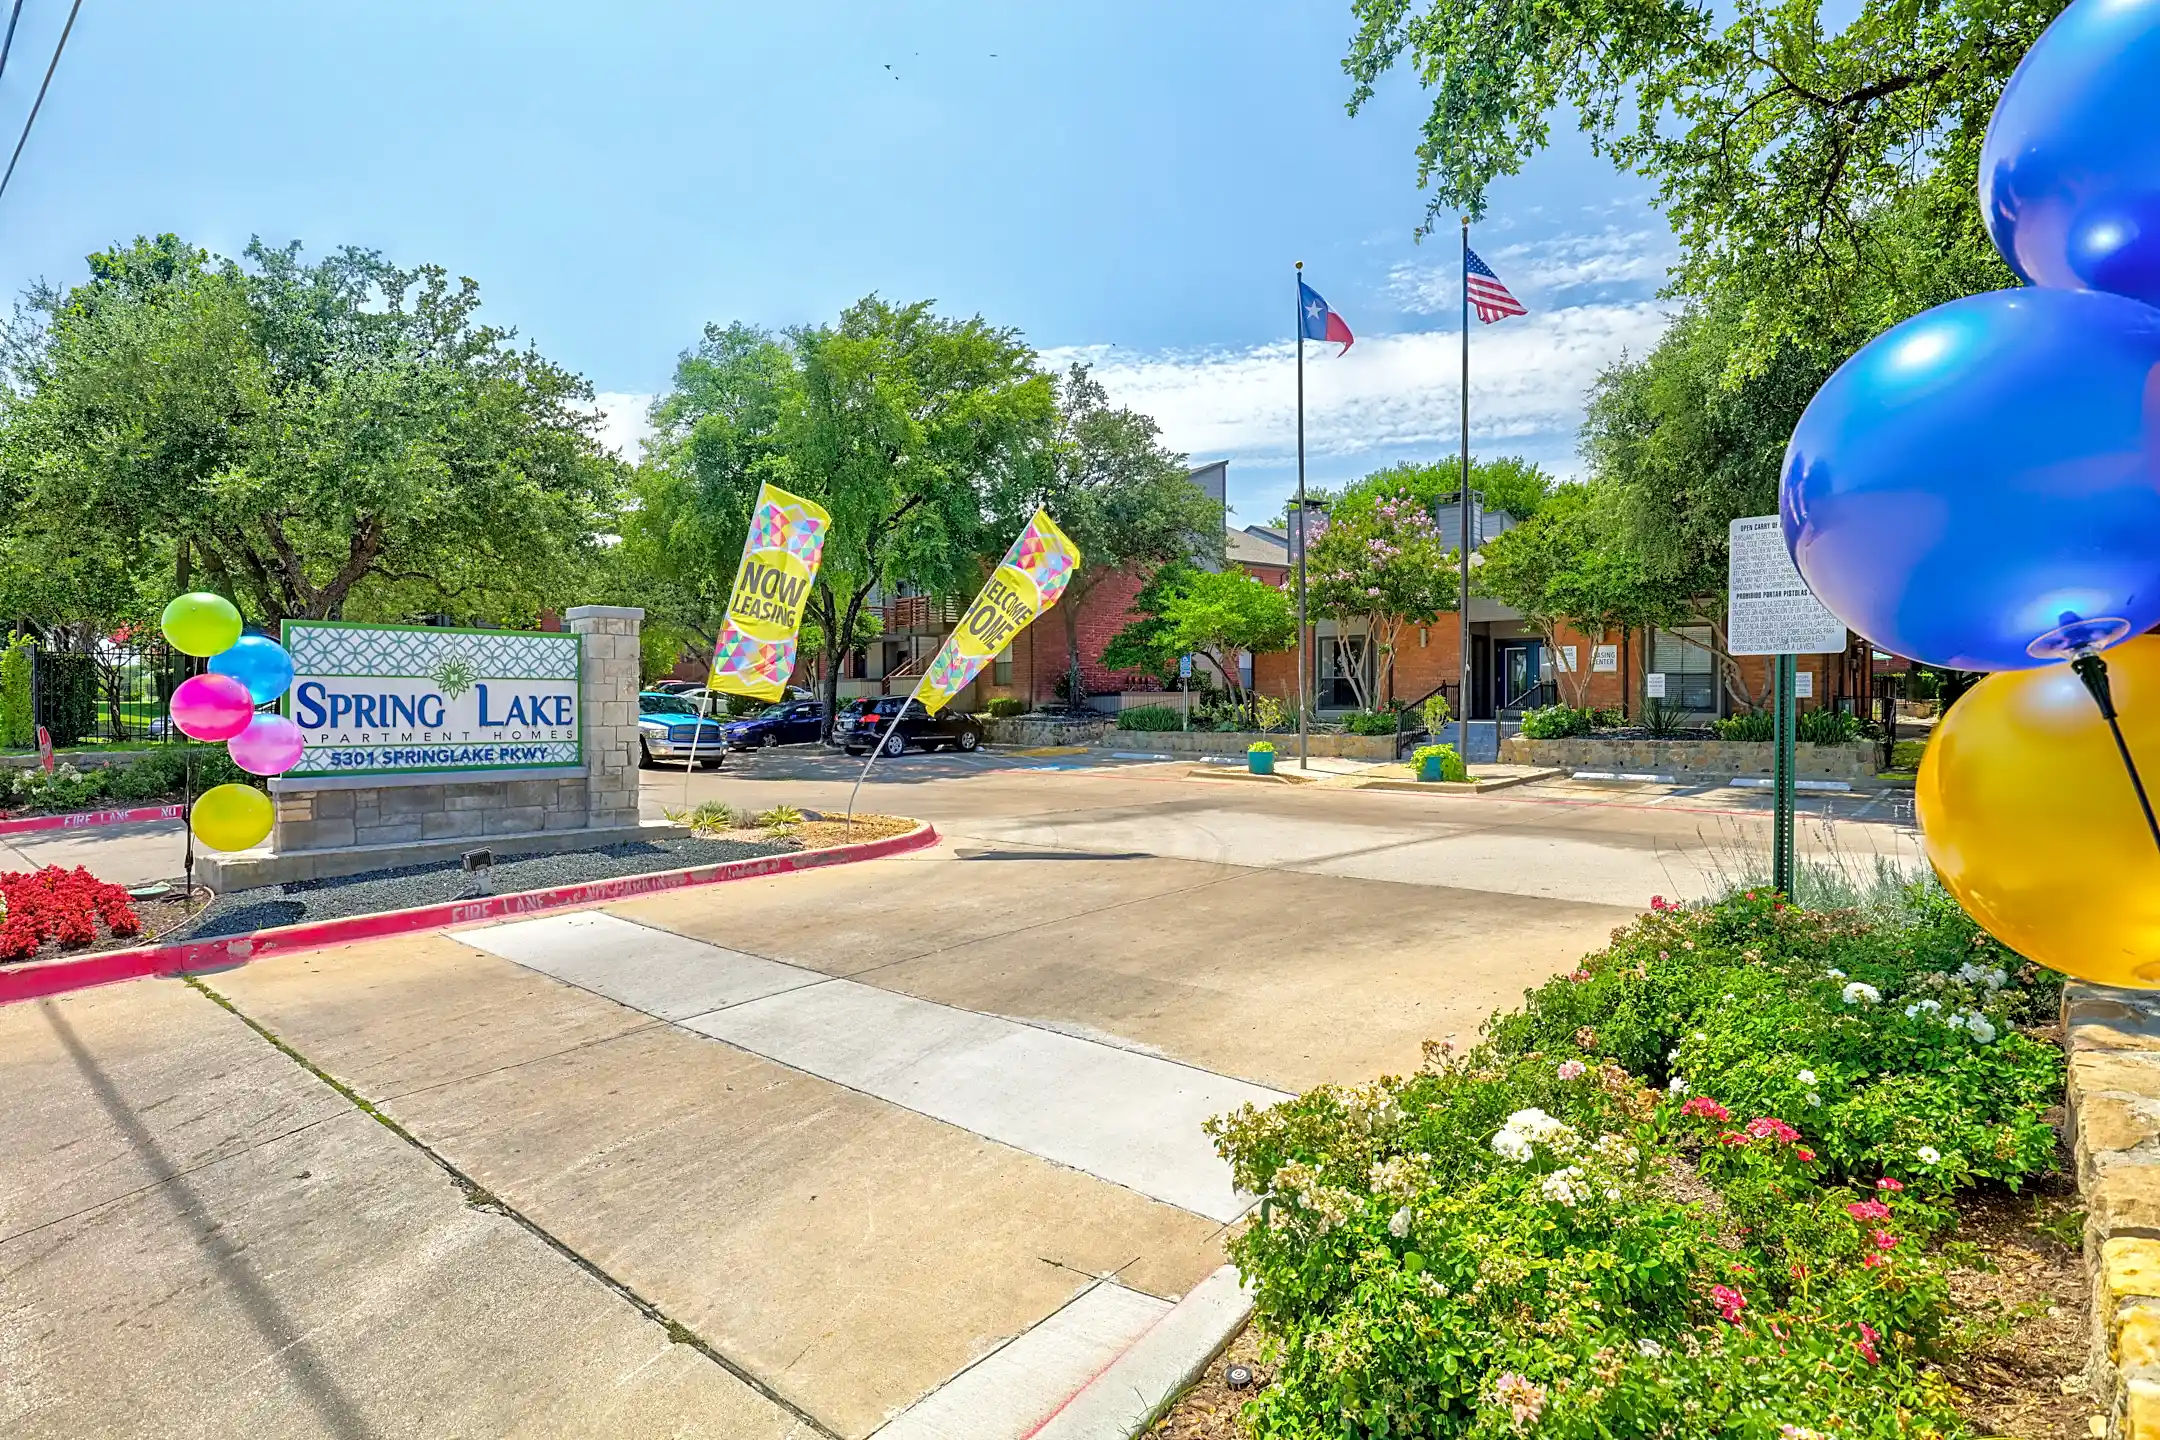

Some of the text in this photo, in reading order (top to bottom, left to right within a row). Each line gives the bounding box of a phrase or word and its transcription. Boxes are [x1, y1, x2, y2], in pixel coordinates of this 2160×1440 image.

[740, 562, 807, 608] NOW
[1737, 592, 1762, 600] PROHIBIDO
[1784, 589, 1808, 597] PISTOLAS
[731, 593, 796, 628] LEASING
[297, 682, 573, 729] SPRING LAKE
[494, 730, 573, 740] HOMES
[331, 747, 548, 766] 5301 SPRINGLAKE PKWY
[64, 807, 176, 827] FIRE LANE NO
[453, 901, 493, 923] FIRE
[504, 894, 546, 914] LANE
